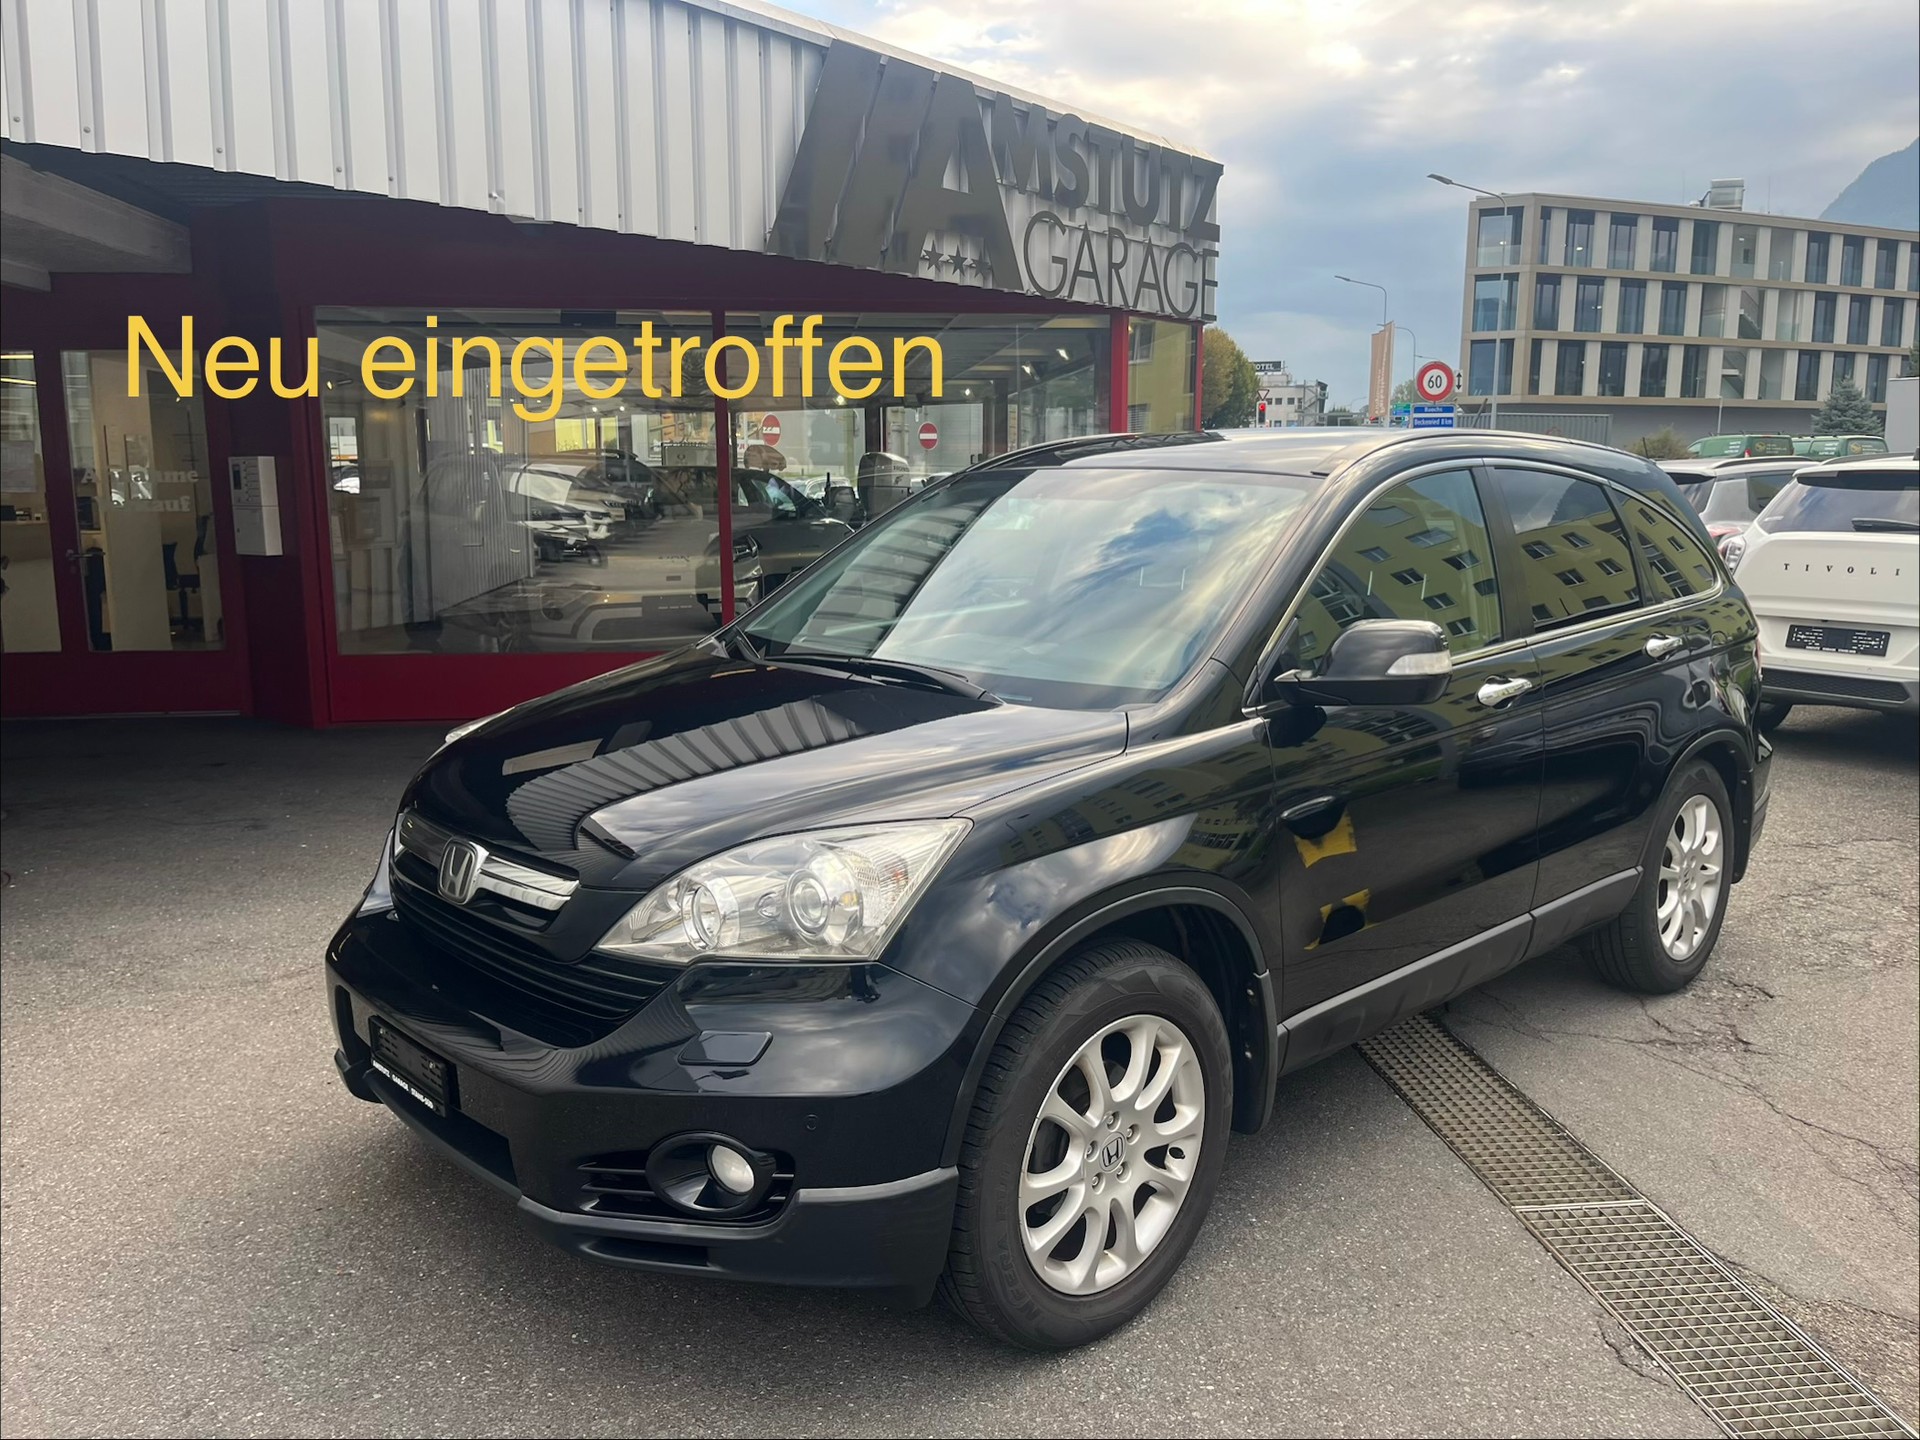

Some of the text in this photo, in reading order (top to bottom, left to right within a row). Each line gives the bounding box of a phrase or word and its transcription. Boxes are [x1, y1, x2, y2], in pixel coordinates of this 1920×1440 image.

[882, 71, 1224, 290] AMSTUTZ
[1023, 211, 1219, 321] GARAGE
[1427, 374, 1442, 389] 60
[1784, 563, 1900, 576] TIVOLI
